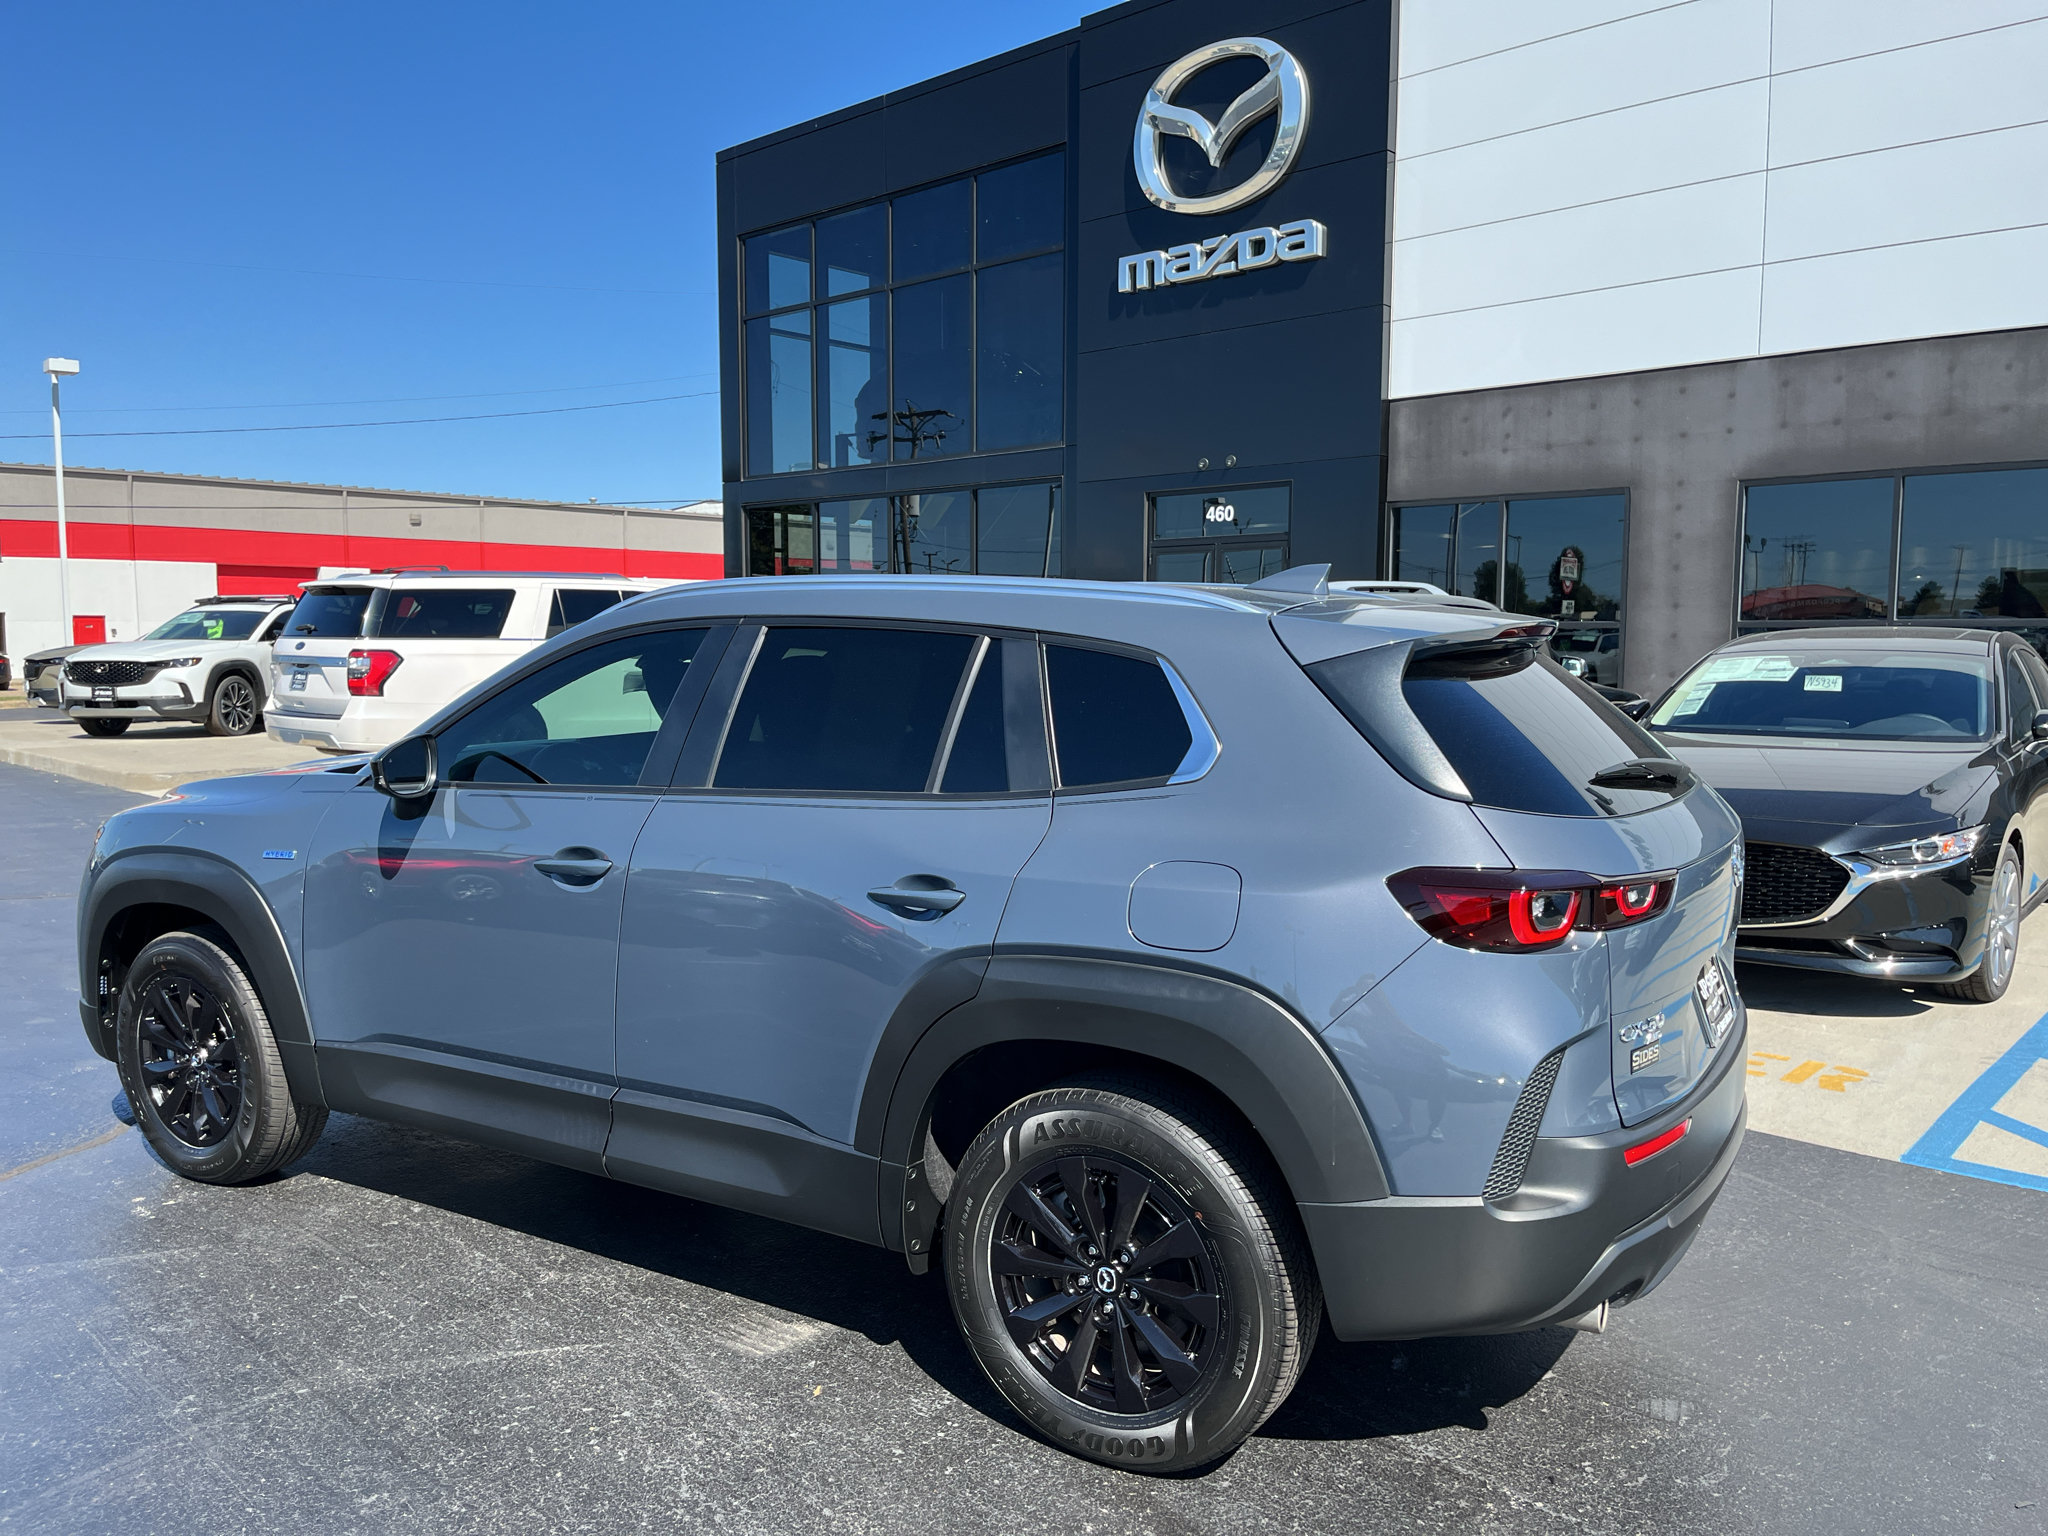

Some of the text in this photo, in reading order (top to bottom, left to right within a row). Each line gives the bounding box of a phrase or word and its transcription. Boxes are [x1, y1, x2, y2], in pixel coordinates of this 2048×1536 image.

[1205, 504, 1235, 522] 460
[264, 850, 294, 858] HYBRID
[1619, 1012, 1665, 1042] CX-50
[1632, 1044, 1659, 1067] SIDES
[1033, 1117, 1204, 1198] ASSURANCE
